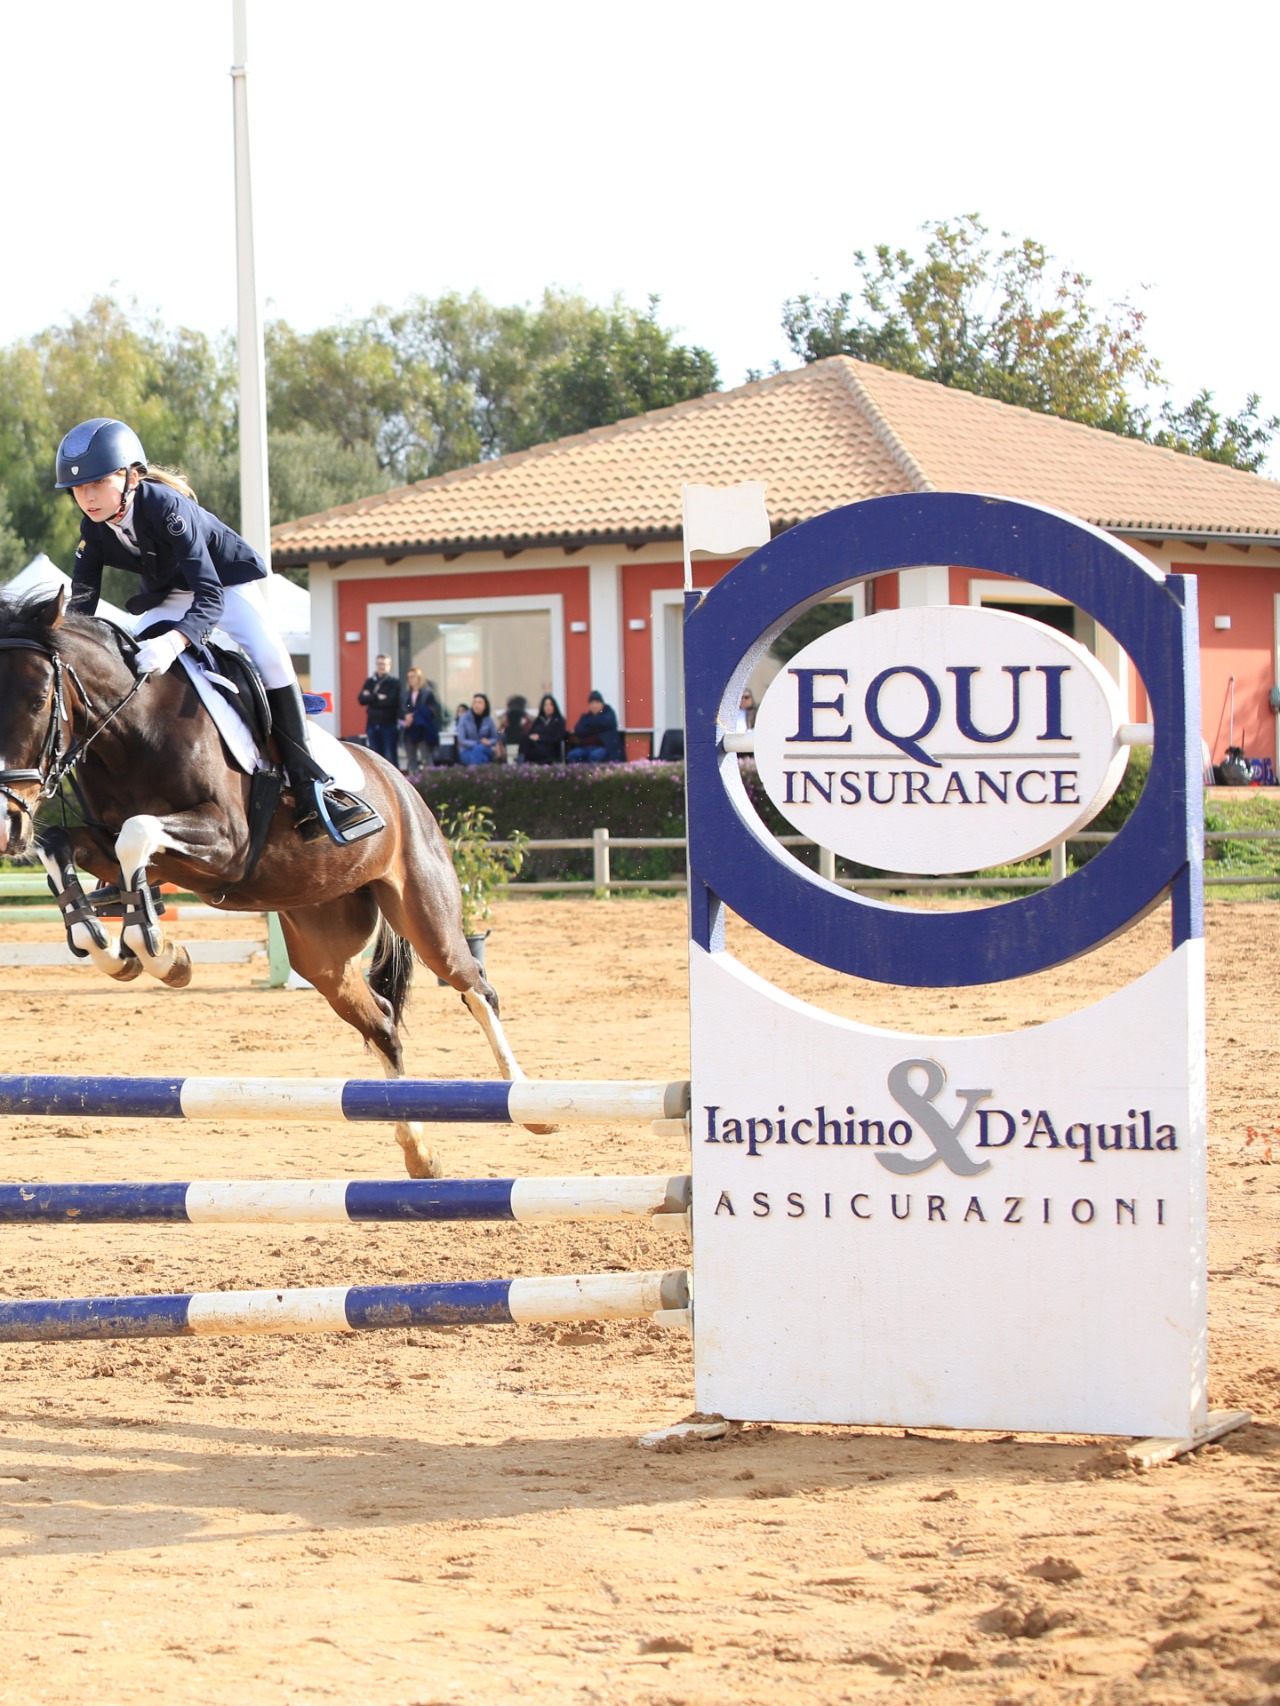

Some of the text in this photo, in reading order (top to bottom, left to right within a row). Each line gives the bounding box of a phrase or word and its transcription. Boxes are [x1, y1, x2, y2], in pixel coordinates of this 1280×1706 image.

[784, 665, 1073, 768] EQUI
[782, 769, 1081, 805] INSURANCE
[703, 1104, 913, 1157] Iapichino
[874, 1058, 993, 1176] &
[714, 1190, 1164, 1225] ASSICURAZIONI
